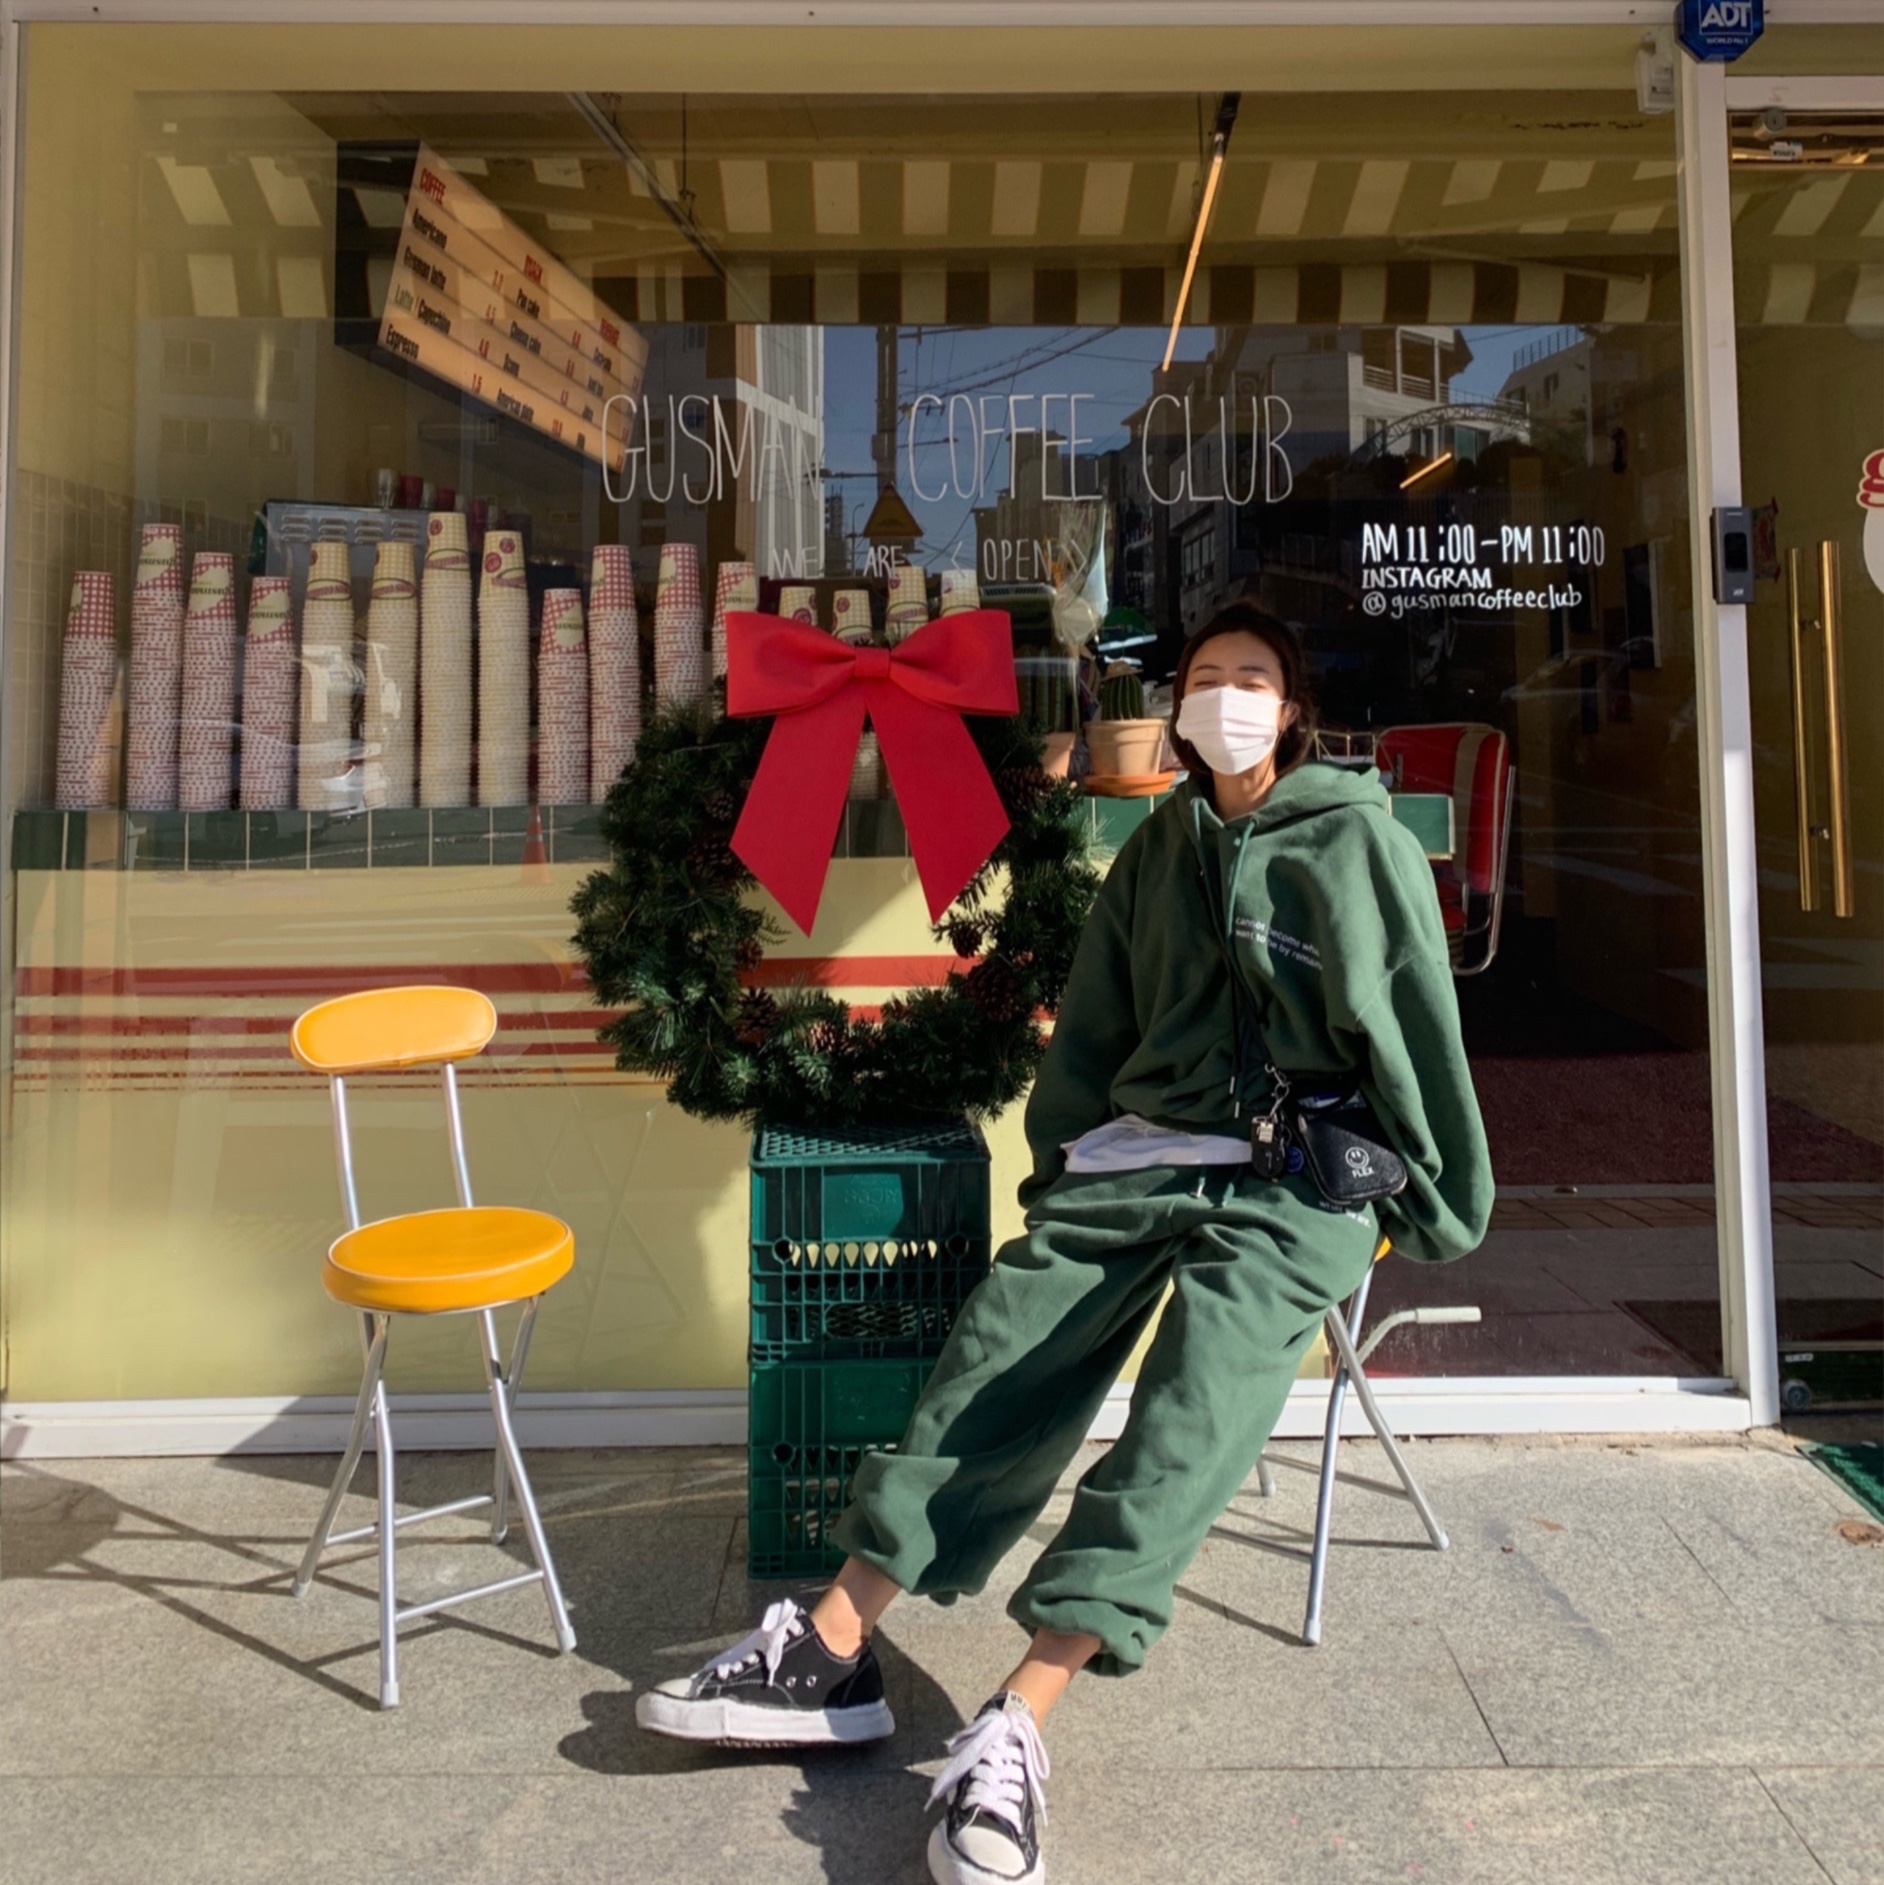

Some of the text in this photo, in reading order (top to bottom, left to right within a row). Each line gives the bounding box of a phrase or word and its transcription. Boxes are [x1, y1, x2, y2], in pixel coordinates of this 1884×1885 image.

[1701, 1, 1751, 28] ADT
[419, 168, 446, 206] COFFEE
[386, 323, 419, 360] Espresso
[601, 393, 1293, 505] GUSMAN COFFEE CLUB
[771, 545, 819, 578] WE
[863, 545, 904, 578] ARE
[983, 538, 1053, 581] OPEN
[1362, 523, 1399, 563] AM
[1500, 526, 1533, 564] PM
[1362, 567, 1493, 590] INSTAGRAM
[1362, 584, 1582, 619] @gusmancoffeeclub
[1256, 932, 1267, 944] to
[1351, 1166, 1374, 1179] FLEX
